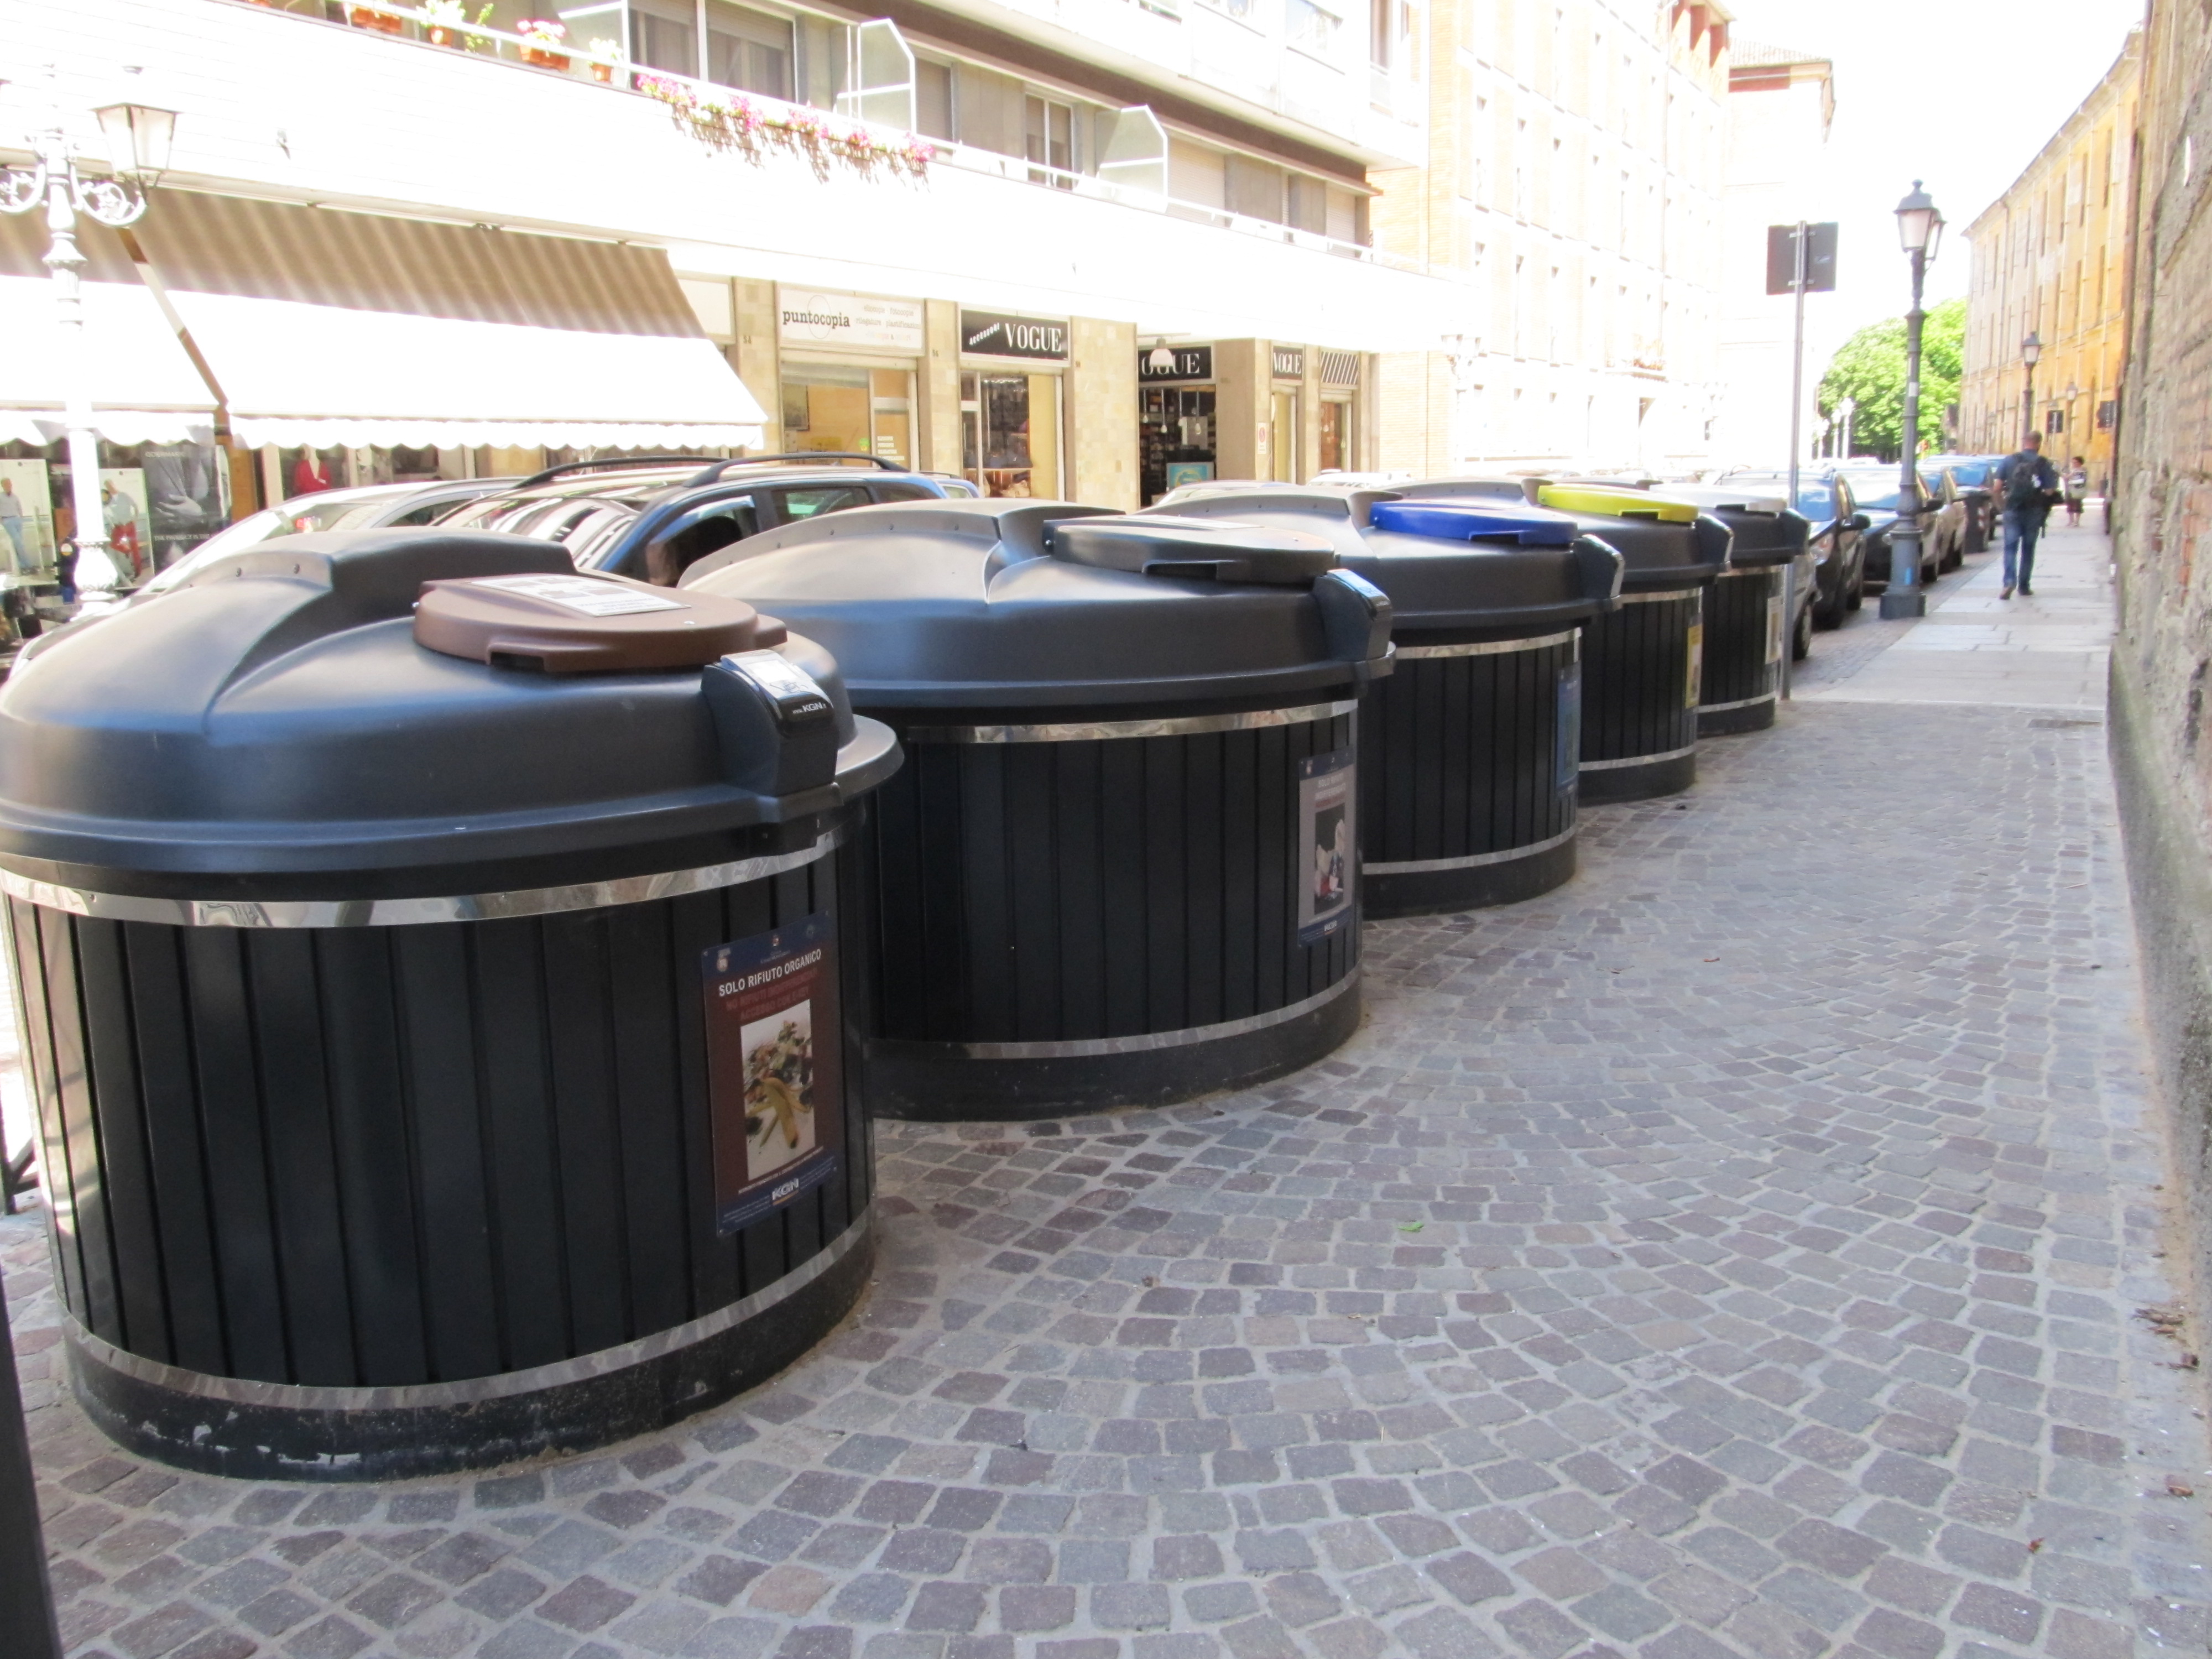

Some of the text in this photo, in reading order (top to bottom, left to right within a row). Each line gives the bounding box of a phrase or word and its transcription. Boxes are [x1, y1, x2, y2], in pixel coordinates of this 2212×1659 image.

[782, 310, 850, 329] puntocopia
[1005, 323, 1062, 352] VOGUE
[1141, 353, 1200, 375] OUE
[1274, 352, 1302, 374] VOGUE
[719, 978, 745, 997] SOLO
[748, 966, 782, 987] RIFIUTO
[784, 948, 821, 974] ORGANICO
[772, 1178, 799, 1201] KGN
